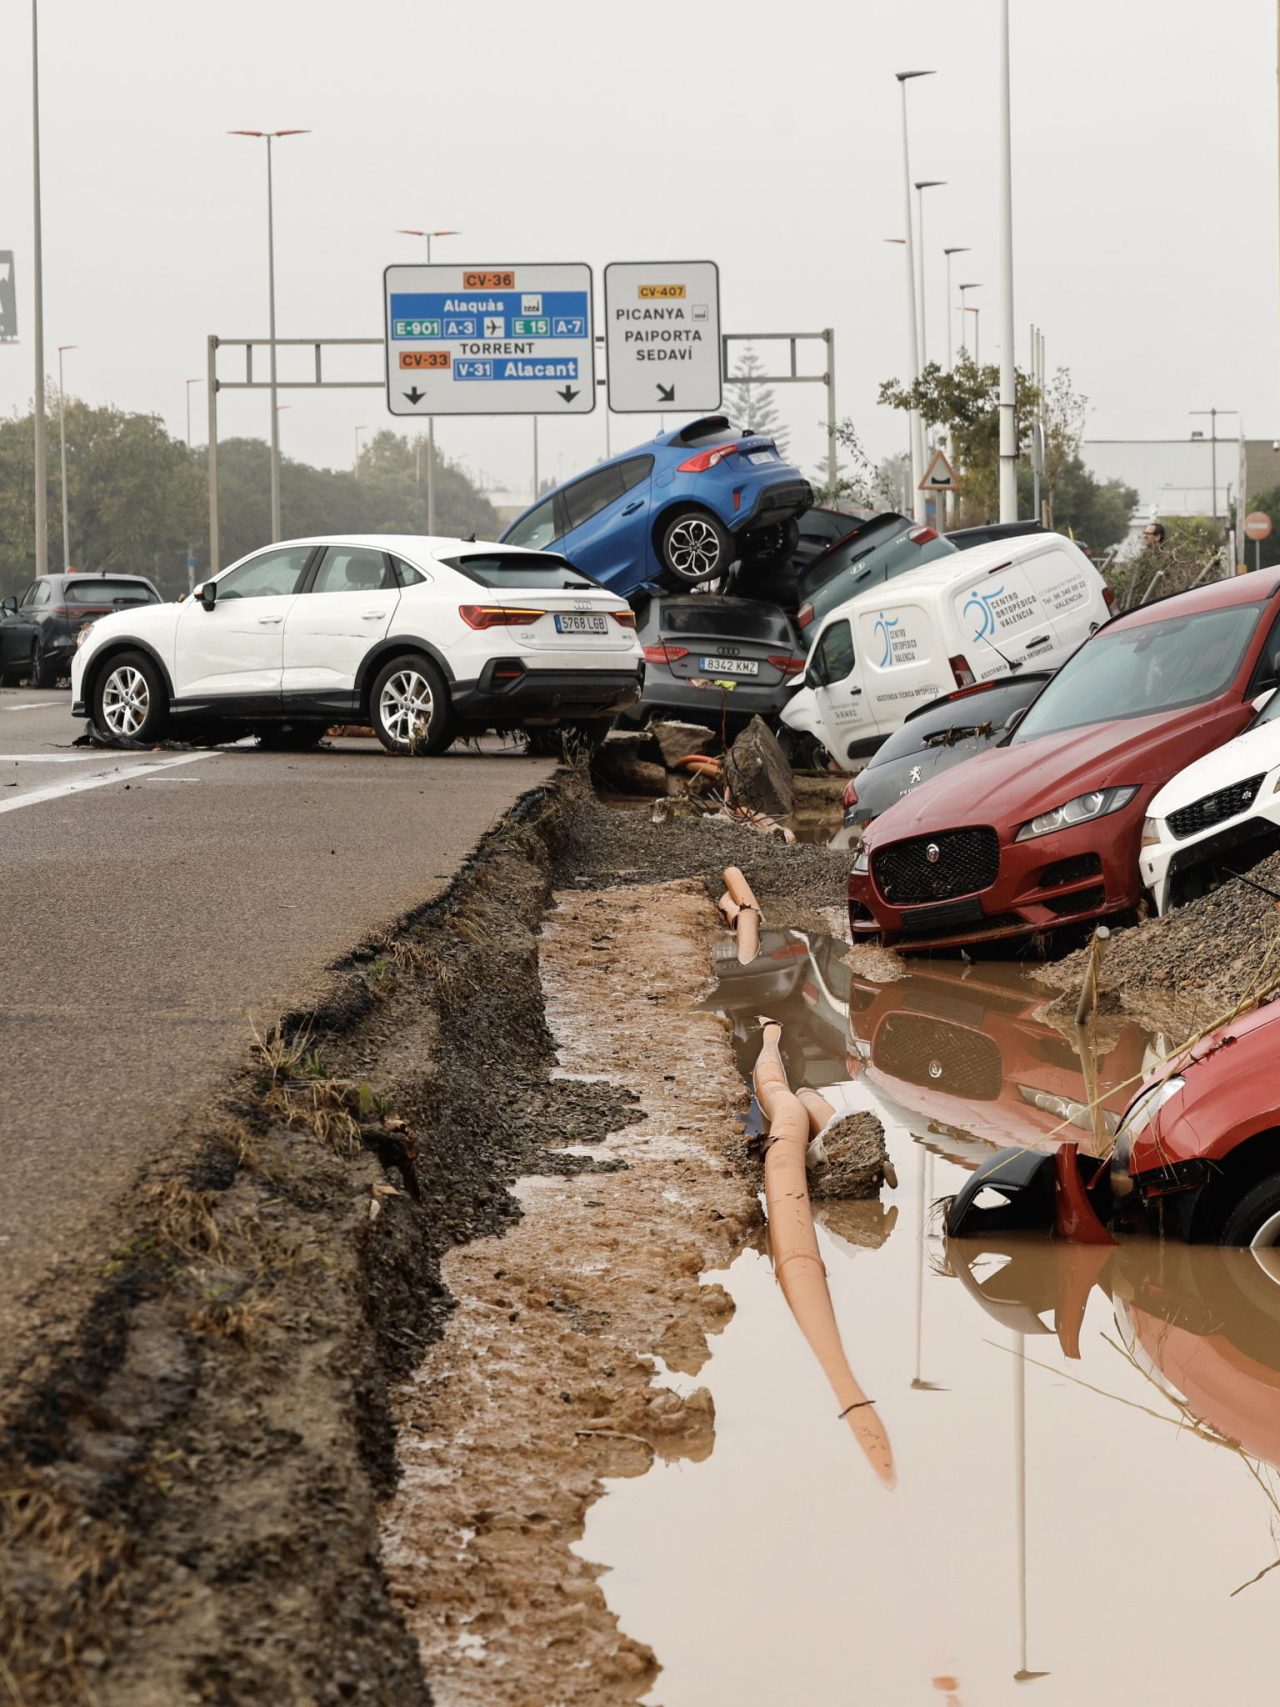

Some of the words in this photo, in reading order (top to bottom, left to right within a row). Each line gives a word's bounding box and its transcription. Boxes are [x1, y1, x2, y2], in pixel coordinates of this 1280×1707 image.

[466, 274, 511, 286] CV-36
[640, 287, 684, 297] CV-407
[444, 298, 504, 314] Alaquàs
[616, 308, 685, 320] PICANYA
[396, 322, 438, 335] E-901
[447, 321, 473, 334] A-3
[515, 321, 524, 333] E
[530, 321, 546, 333] 15
[556, 321, 581, 333] A-7
[625, 329, 702, 342] PAIPORTA
[460, 342, 535, 355] TORRENT
[636, 345, 693, 361] SEDAVÍ
[402, 354, 448, 366] CV-33
[459, 363, 491, 376] V-31
[504, 361, 576, 377] Alacant
[991, 592, 1018, 609] CENTRO
[1054, 592, 1083, 610] VALENCIA
[562, 617, 586, 629] 5768
[588, 617, 605, 630] LGB
[1000, 608, 1034, 628] VALENCIA
[895, 652, 915, 663] VALENCIA
[708, 659, 733, 671] 8342
[736, 661, 755, 672] KMZ
[981, 664, 1007, 680] ASISTENCIA
